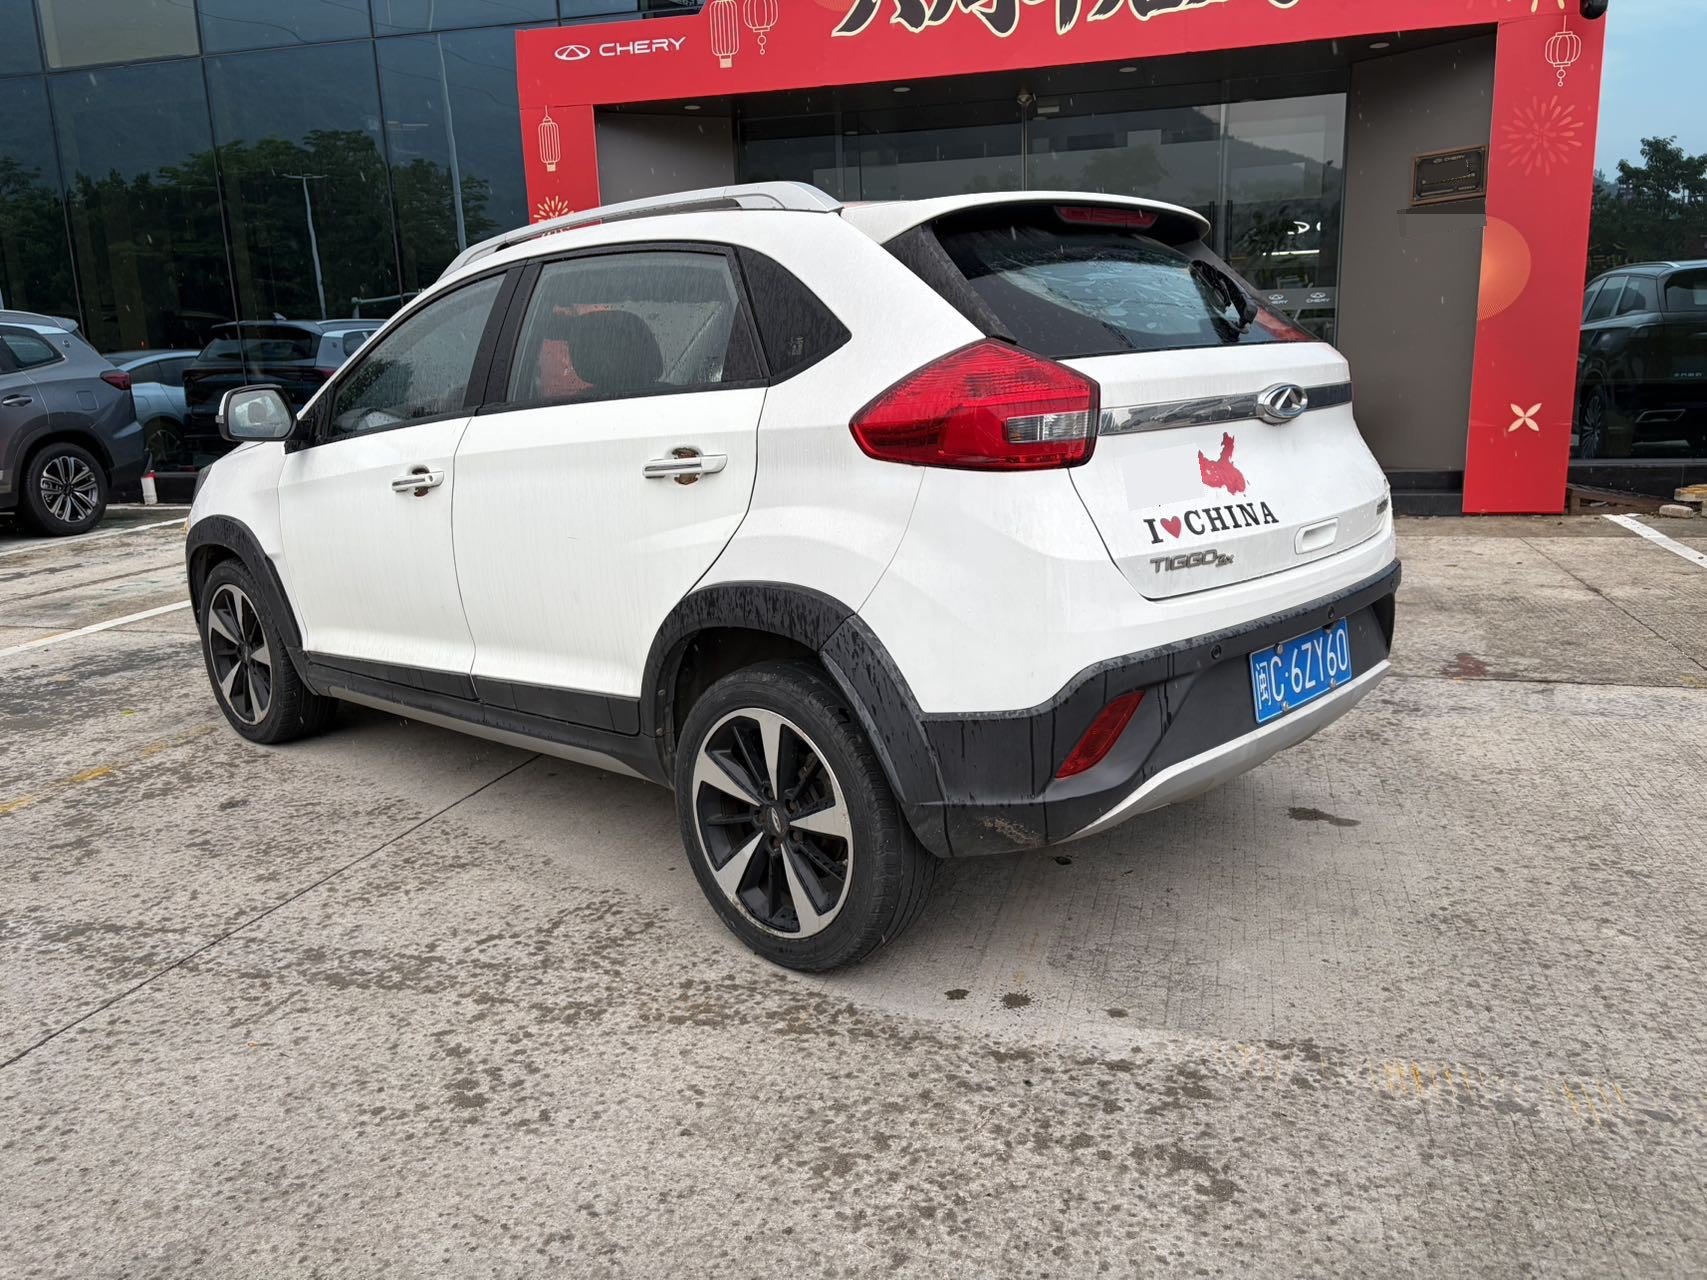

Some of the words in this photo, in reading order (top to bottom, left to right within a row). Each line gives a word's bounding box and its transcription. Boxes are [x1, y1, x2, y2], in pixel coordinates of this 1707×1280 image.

[599, 36, 687, 57] CHERY
[1143, 518, 1164, 544] I
[1183, 501, 1280, 536] CHINA
